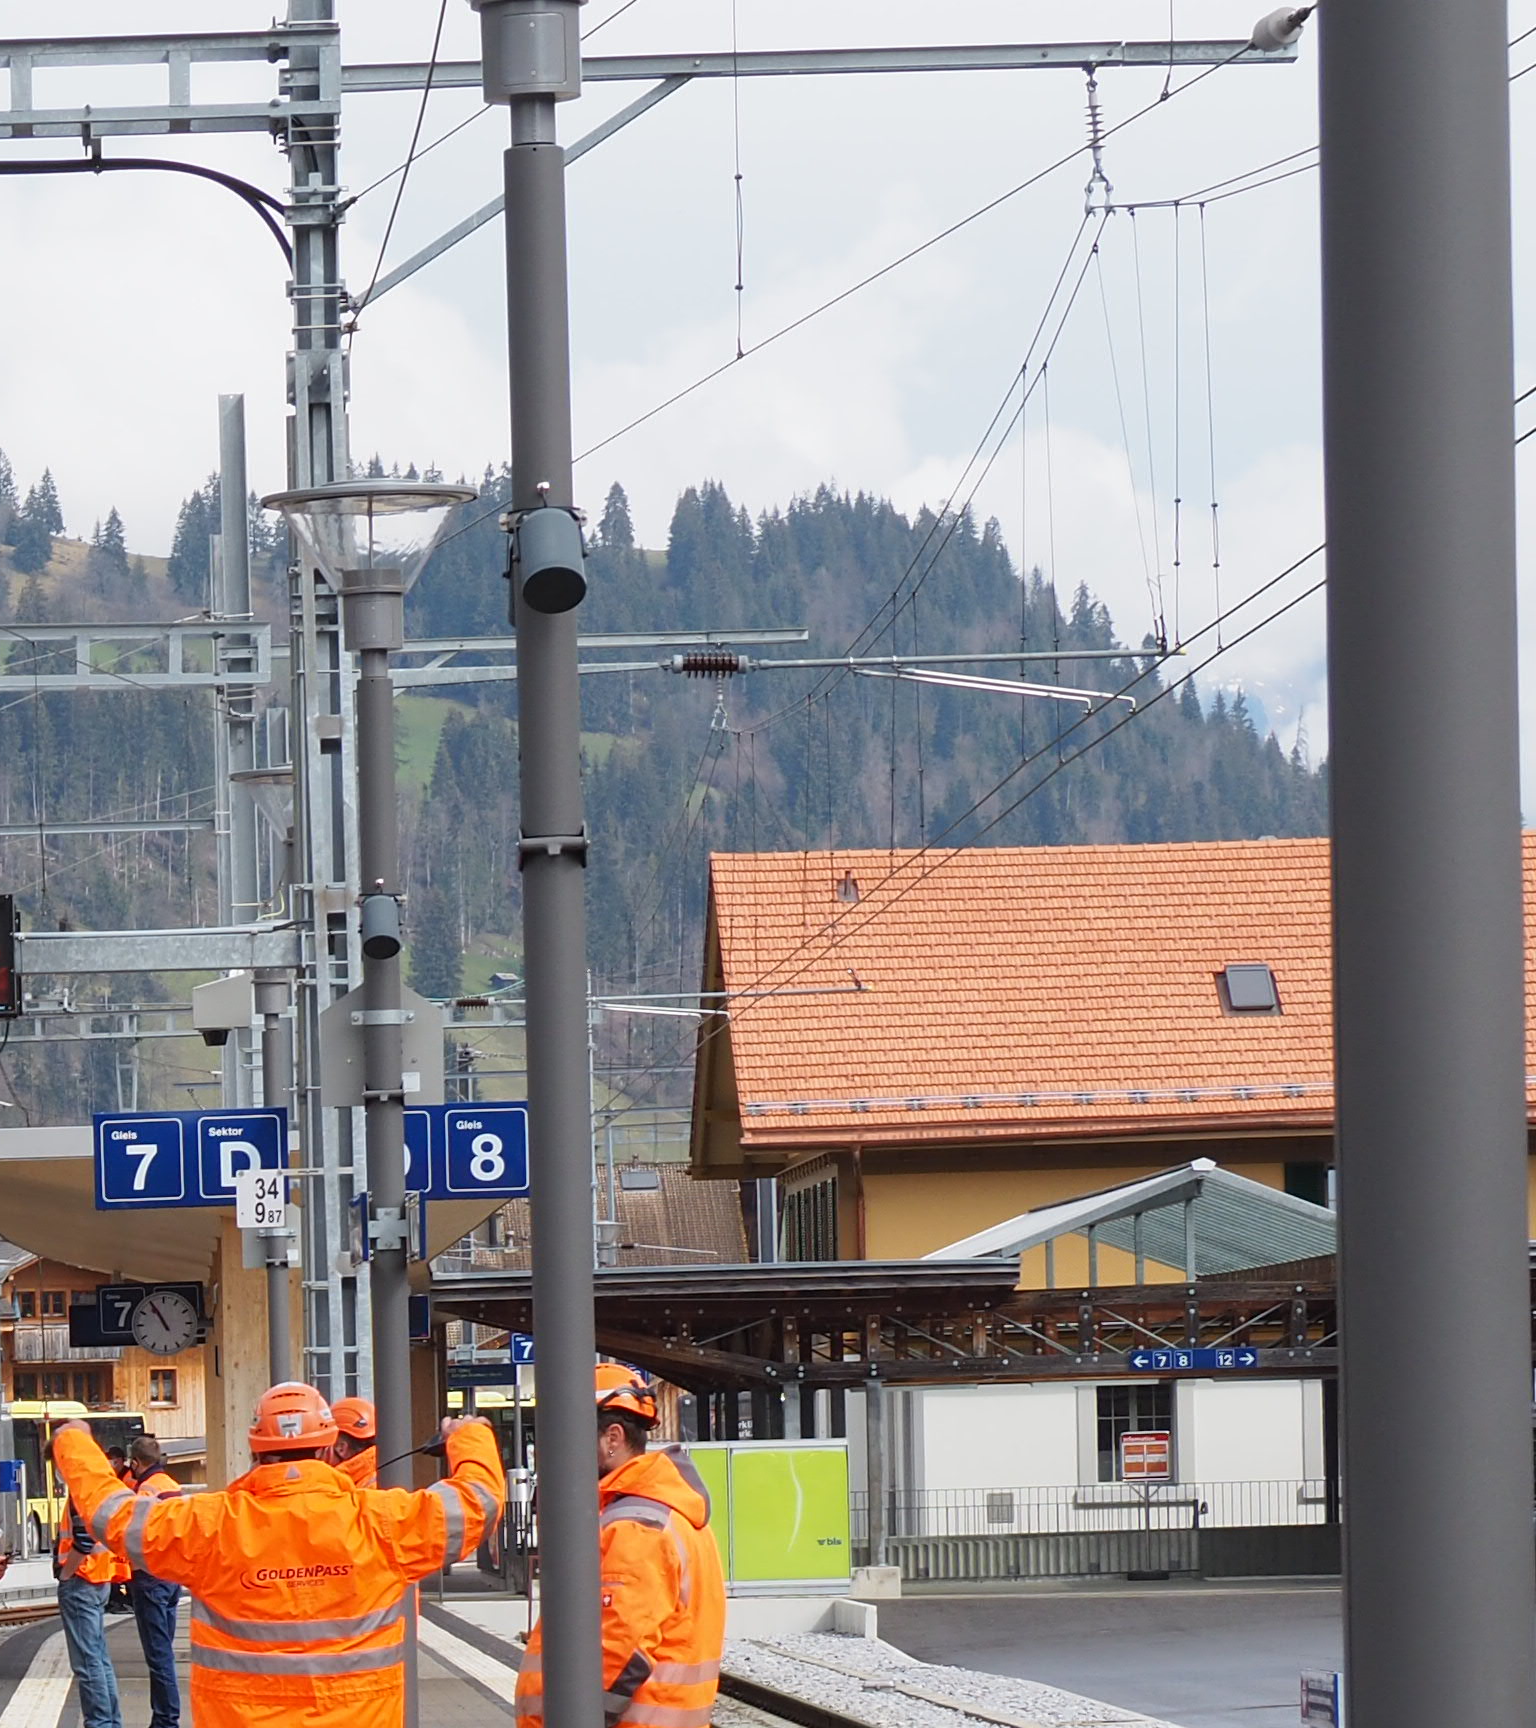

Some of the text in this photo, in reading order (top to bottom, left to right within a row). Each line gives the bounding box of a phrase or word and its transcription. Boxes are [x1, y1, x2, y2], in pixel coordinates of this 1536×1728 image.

[208, 1127, 244, 1137] Sektor
[456, 1120, 483, 1130] Gleis
[111, 1131, 138, 1140] Gleis
[219, 1141, 261, 1188] D
[470, 1133, 505, 1181] 8
[125, 1144, 158, 1191] 7
[255, 1178, 279, 1200] 34
[114, 1301, 132, 1328] 7
[520, 1341, 534, 1359] 7
[1157, 1355, 1189, 1367] 7 8
[1218, 1354, 1233, 1366] 12
